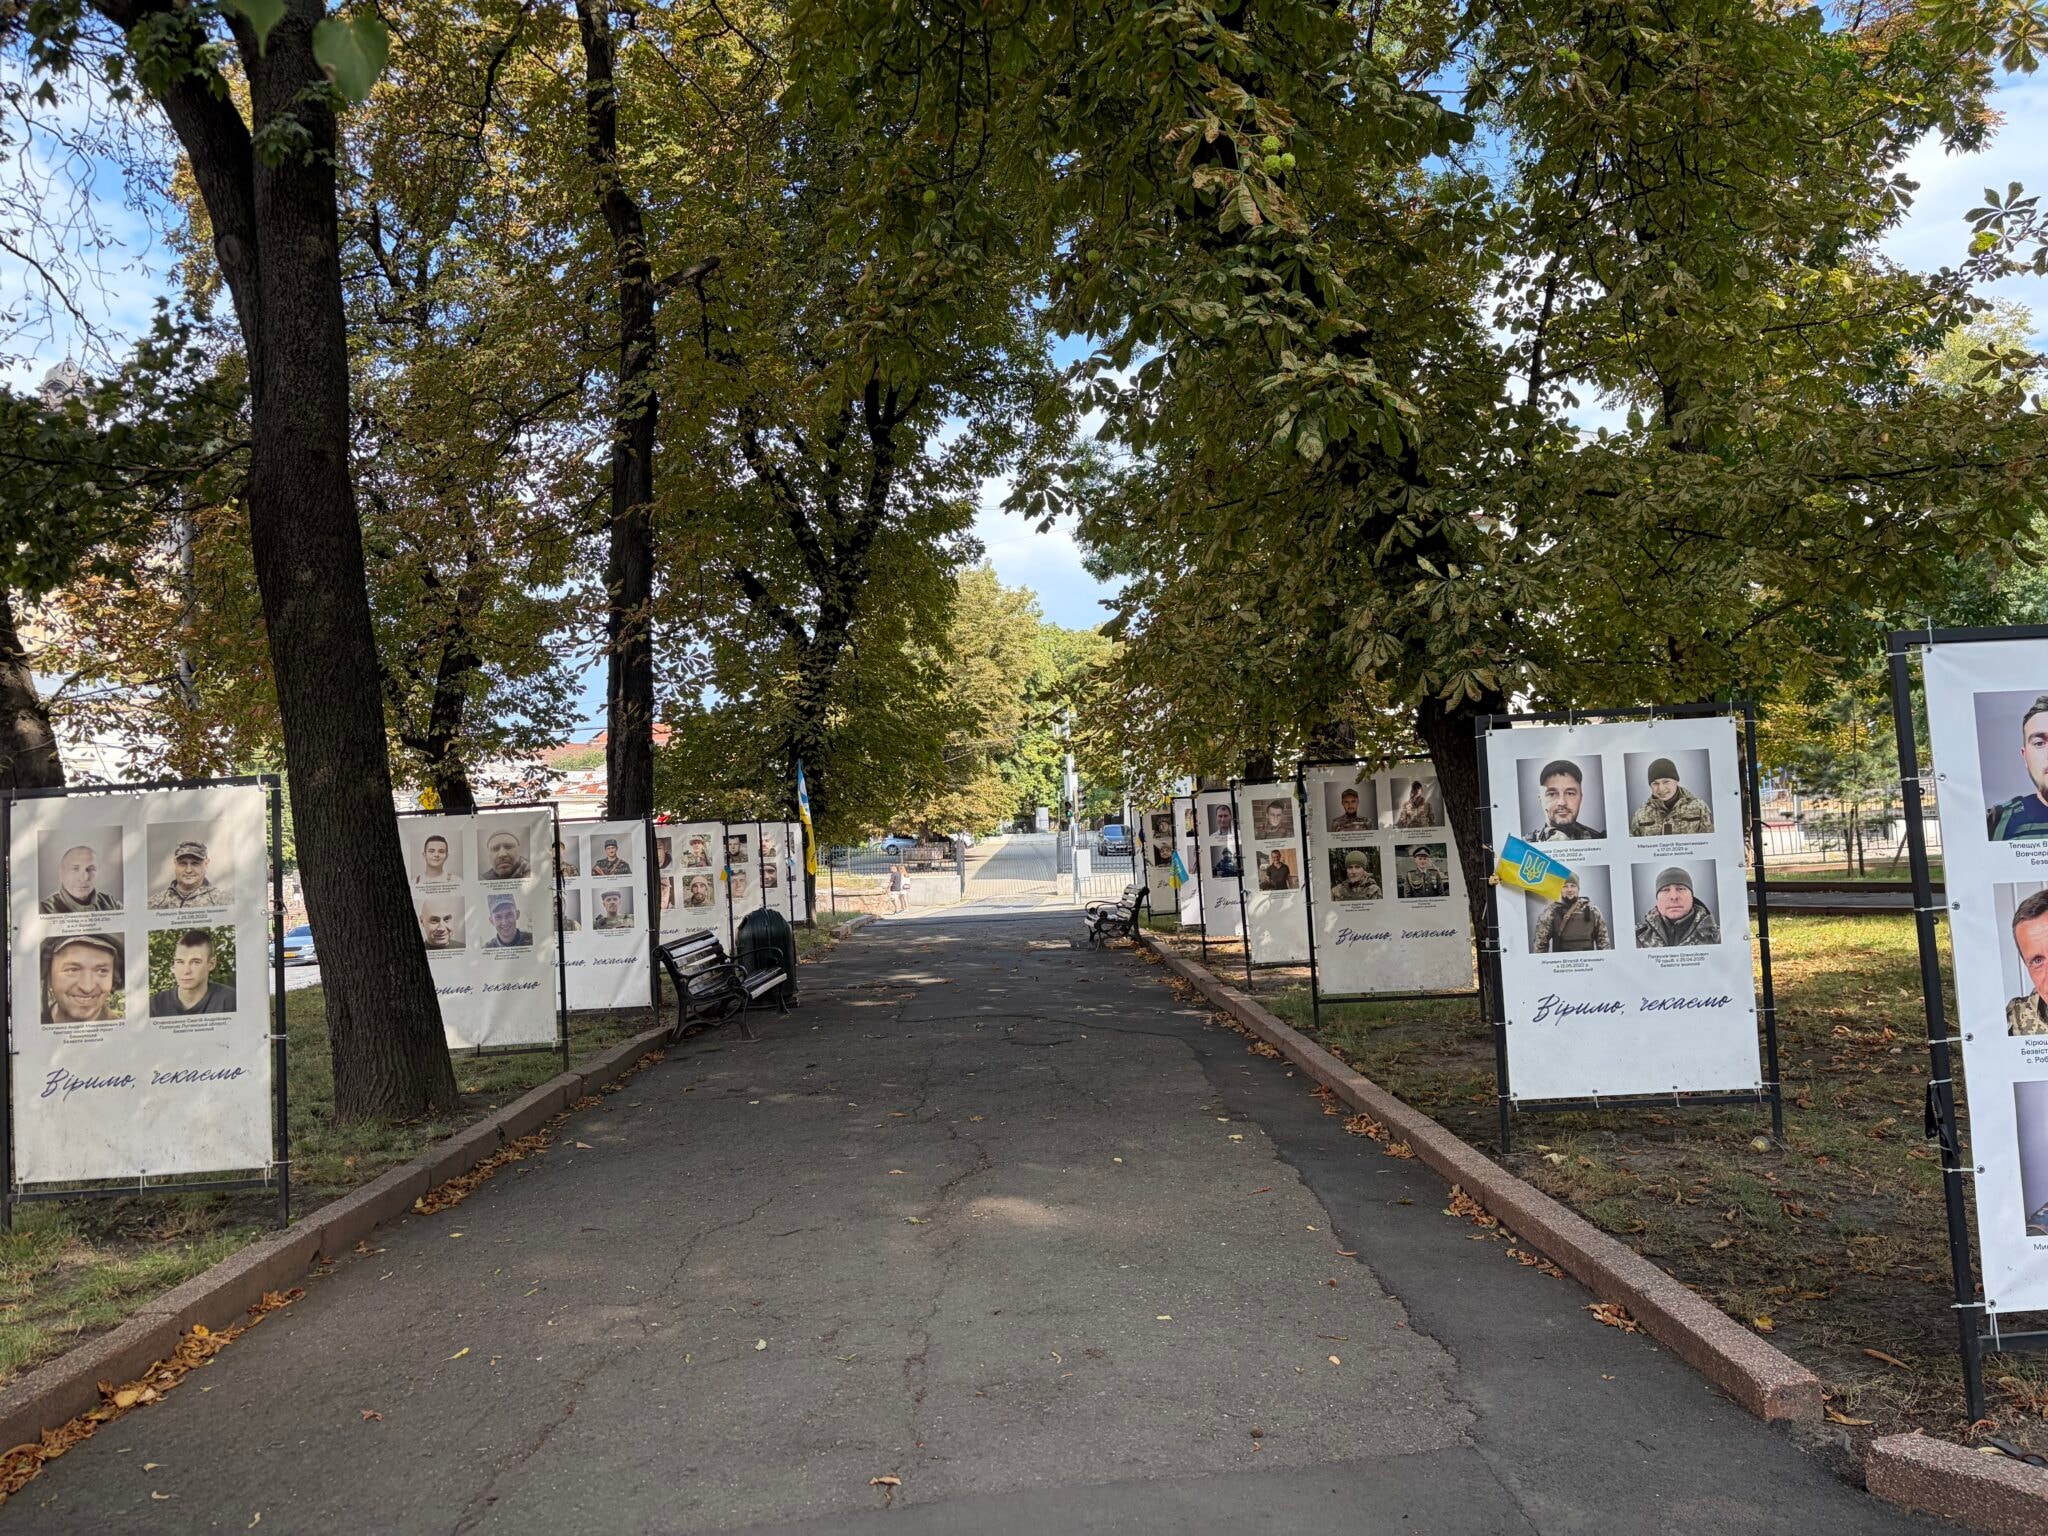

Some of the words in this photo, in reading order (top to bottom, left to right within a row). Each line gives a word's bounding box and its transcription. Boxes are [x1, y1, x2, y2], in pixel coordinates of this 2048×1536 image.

[1336, 928, 1392, 947] Віримо,
[1401, 929, 1459, 939] чекаємо
[483, 980, 542, 993] чекаємо
[1532, 994, 1627, 1026] Віримо,
[1640, 995, 1733, 1012] чекаємо
[41, 1068, 137, 1101] Віримо,
[151, 1066, 248, 1085] чекаємо
